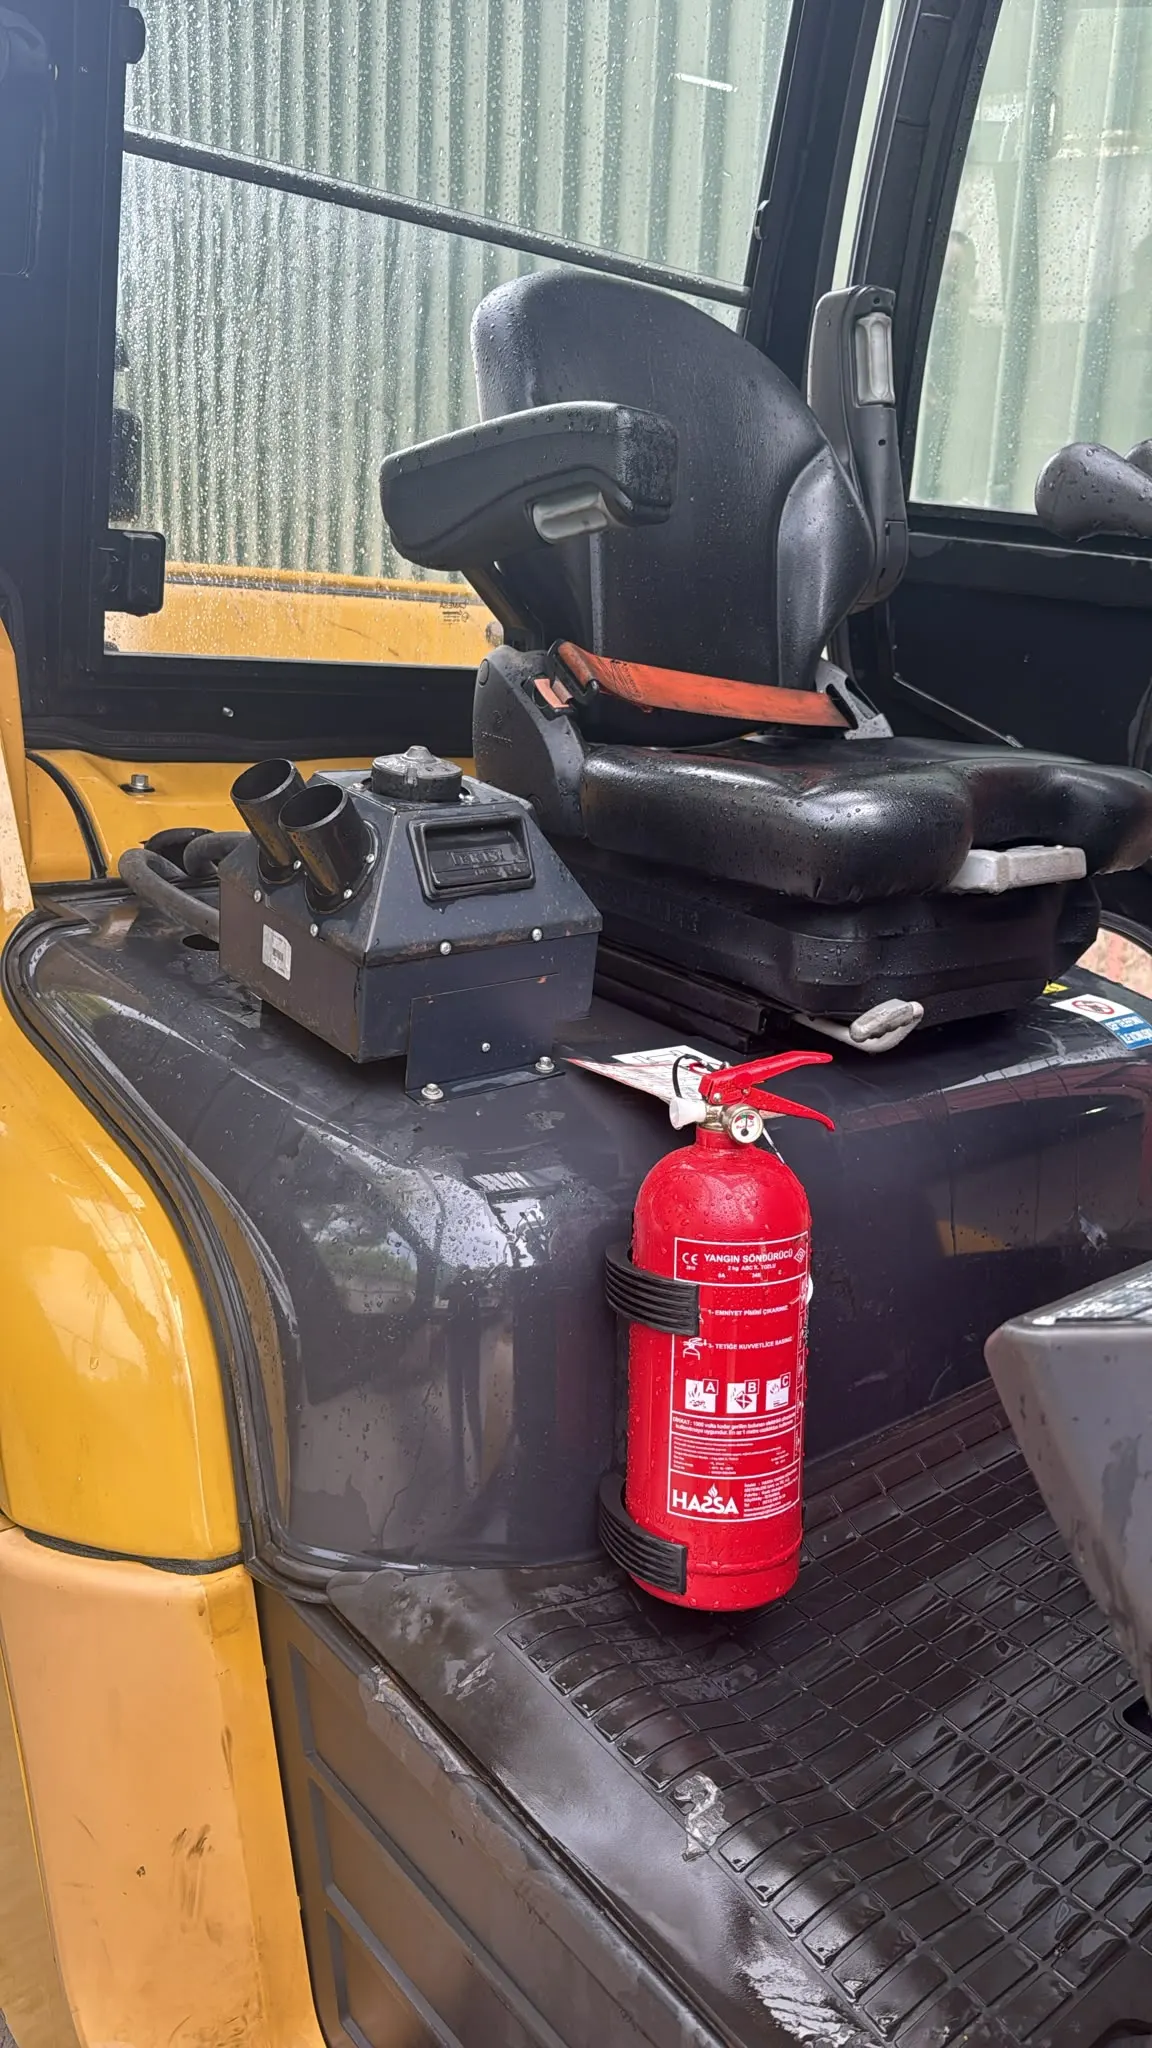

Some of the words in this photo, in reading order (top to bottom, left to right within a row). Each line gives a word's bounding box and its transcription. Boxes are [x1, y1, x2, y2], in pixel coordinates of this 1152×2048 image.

[704, 1253, 740, 1264] YANGIN
[742, 1248, 794, 1263] SÖNDÜRÜCÜ
[715, 1309, 743, 1317] EMNİYET
[715, 1341, 738, 1350] TETİĞE
[738, 1339, 774, 1350] KUVVETLİCE
[781, 1375, 789, 1386] C
[705, 1382, 716, 1393] A
[747, 1382, 757, 1392] B
[671, 1488, 740, 1514] HASSA
